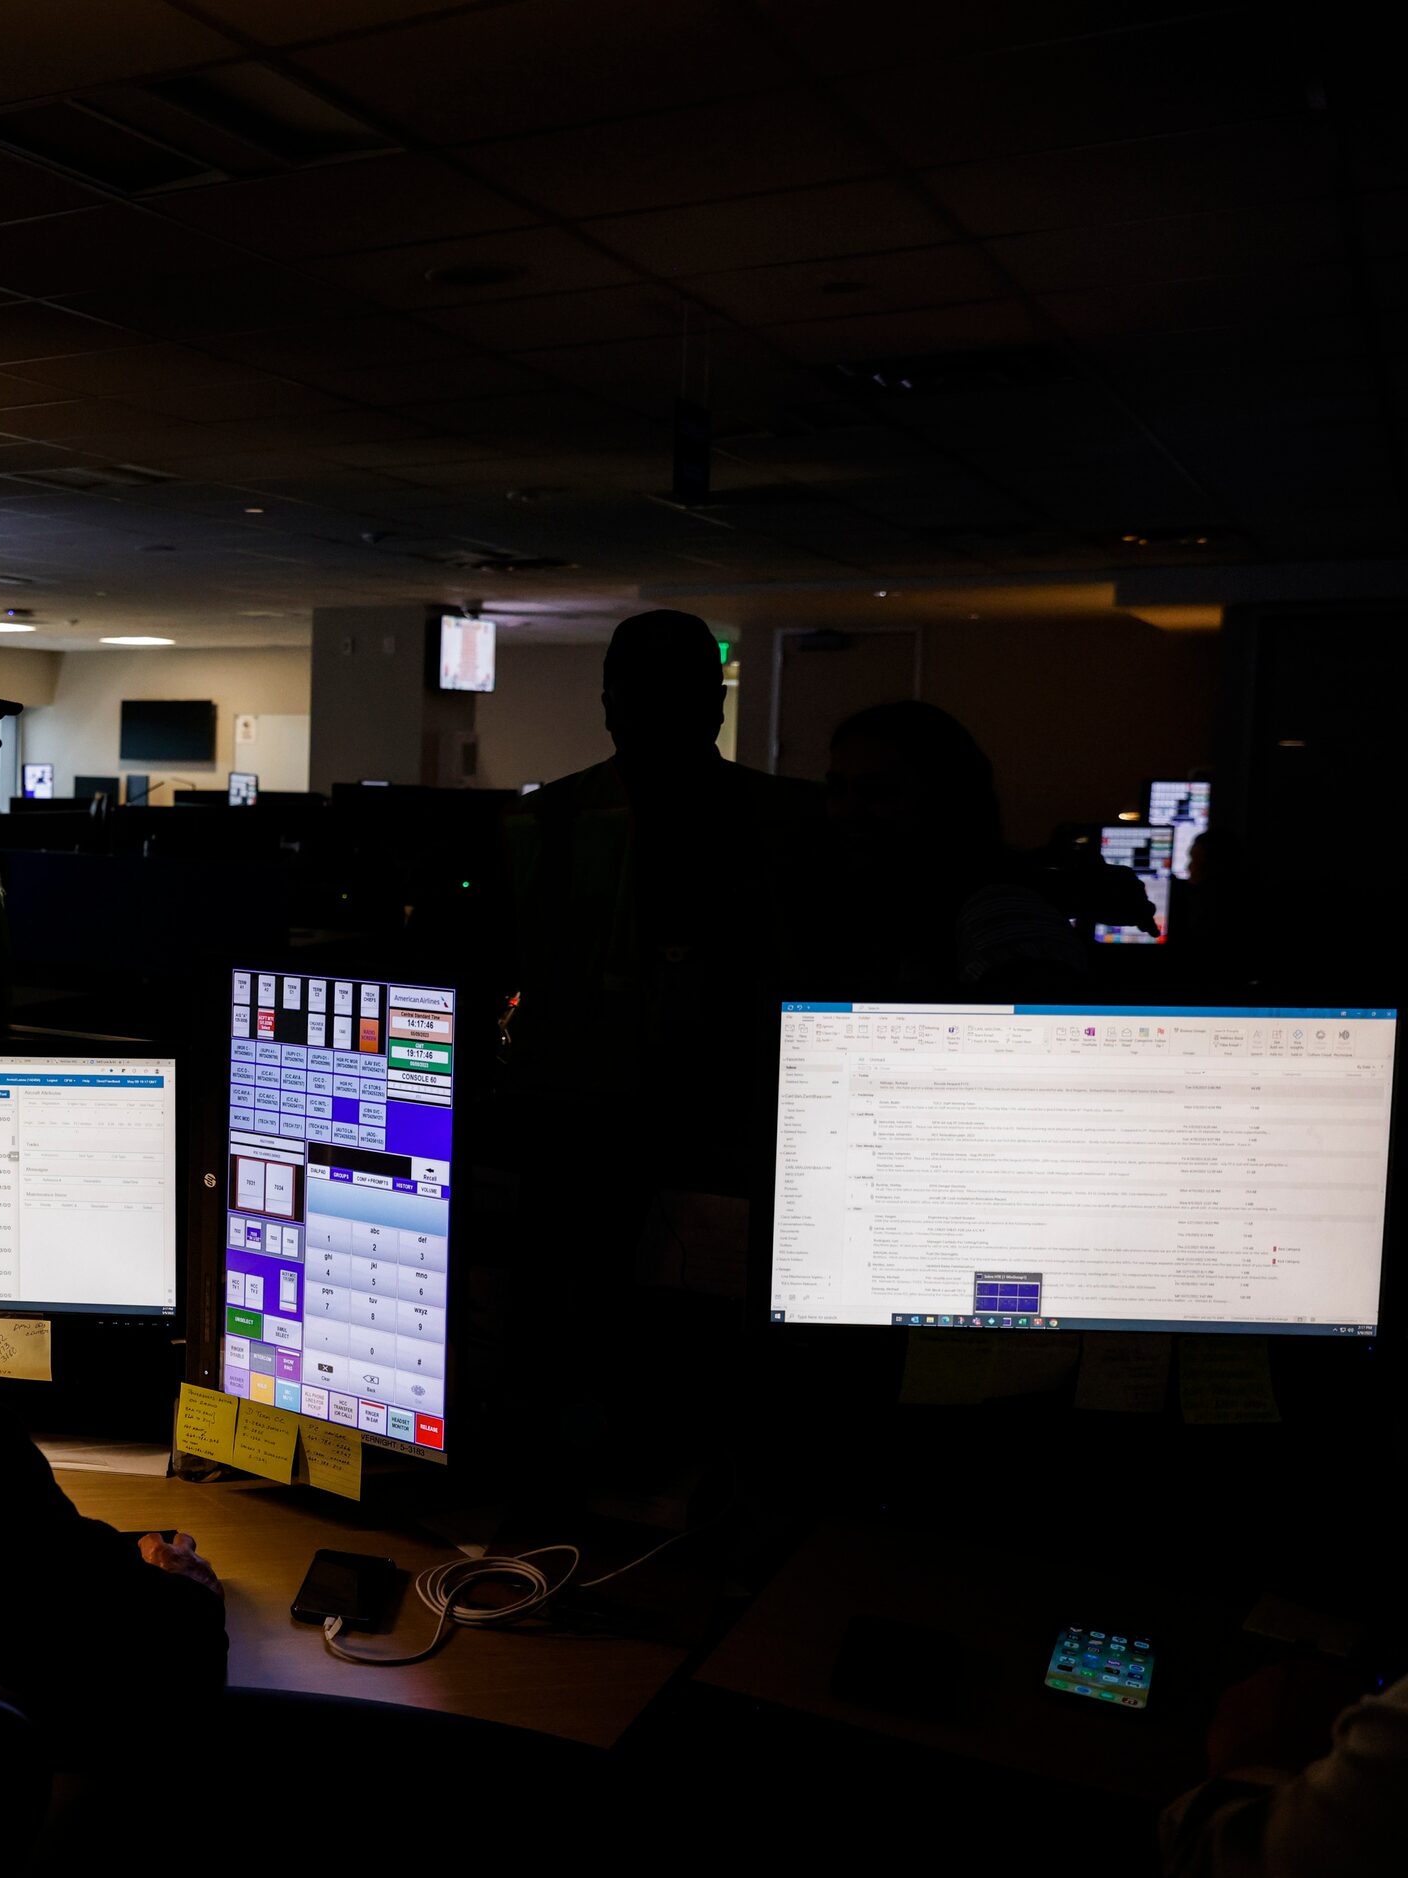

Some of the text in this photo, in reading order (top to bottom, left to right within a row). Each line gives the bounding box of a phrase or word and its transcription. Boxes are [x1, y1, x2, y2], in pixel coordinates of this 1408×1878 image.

[394, 995, 440, 1006] American Airlines
[408, 1020, 433, 1029] 14:17:46
[407, 1050, 433, 1059] 19:17:46
[402, 1073, 428, 1082] CONSOLE
[334, 1172, 349, 1180] GROUPS
[423, 1174, 437, 1182] Recall
[418, 1235, 427, 1243] def
[324, 1253, 333, 1261] ghi
[372, 1278, 375, 1286] 5
[414, 1308, 427, 1316] wxyz
[371, 1313, 375, 1321] 8
[418, 1323, 422, 1331] 9
[254, 1354, 271, 1362] INTERCOM
[334, 1404, 353, 1413] TRANSFER
[366, 1410, 379, 1418] RINGER
[392, 1417, 410, 1425] HEADSET
[392, 1423, 409, 1431] MONITOR
[420, 1424, 438, 1433] RELEASE
[361, 1434, 425, 1456] VERNIGHT 5-3183
